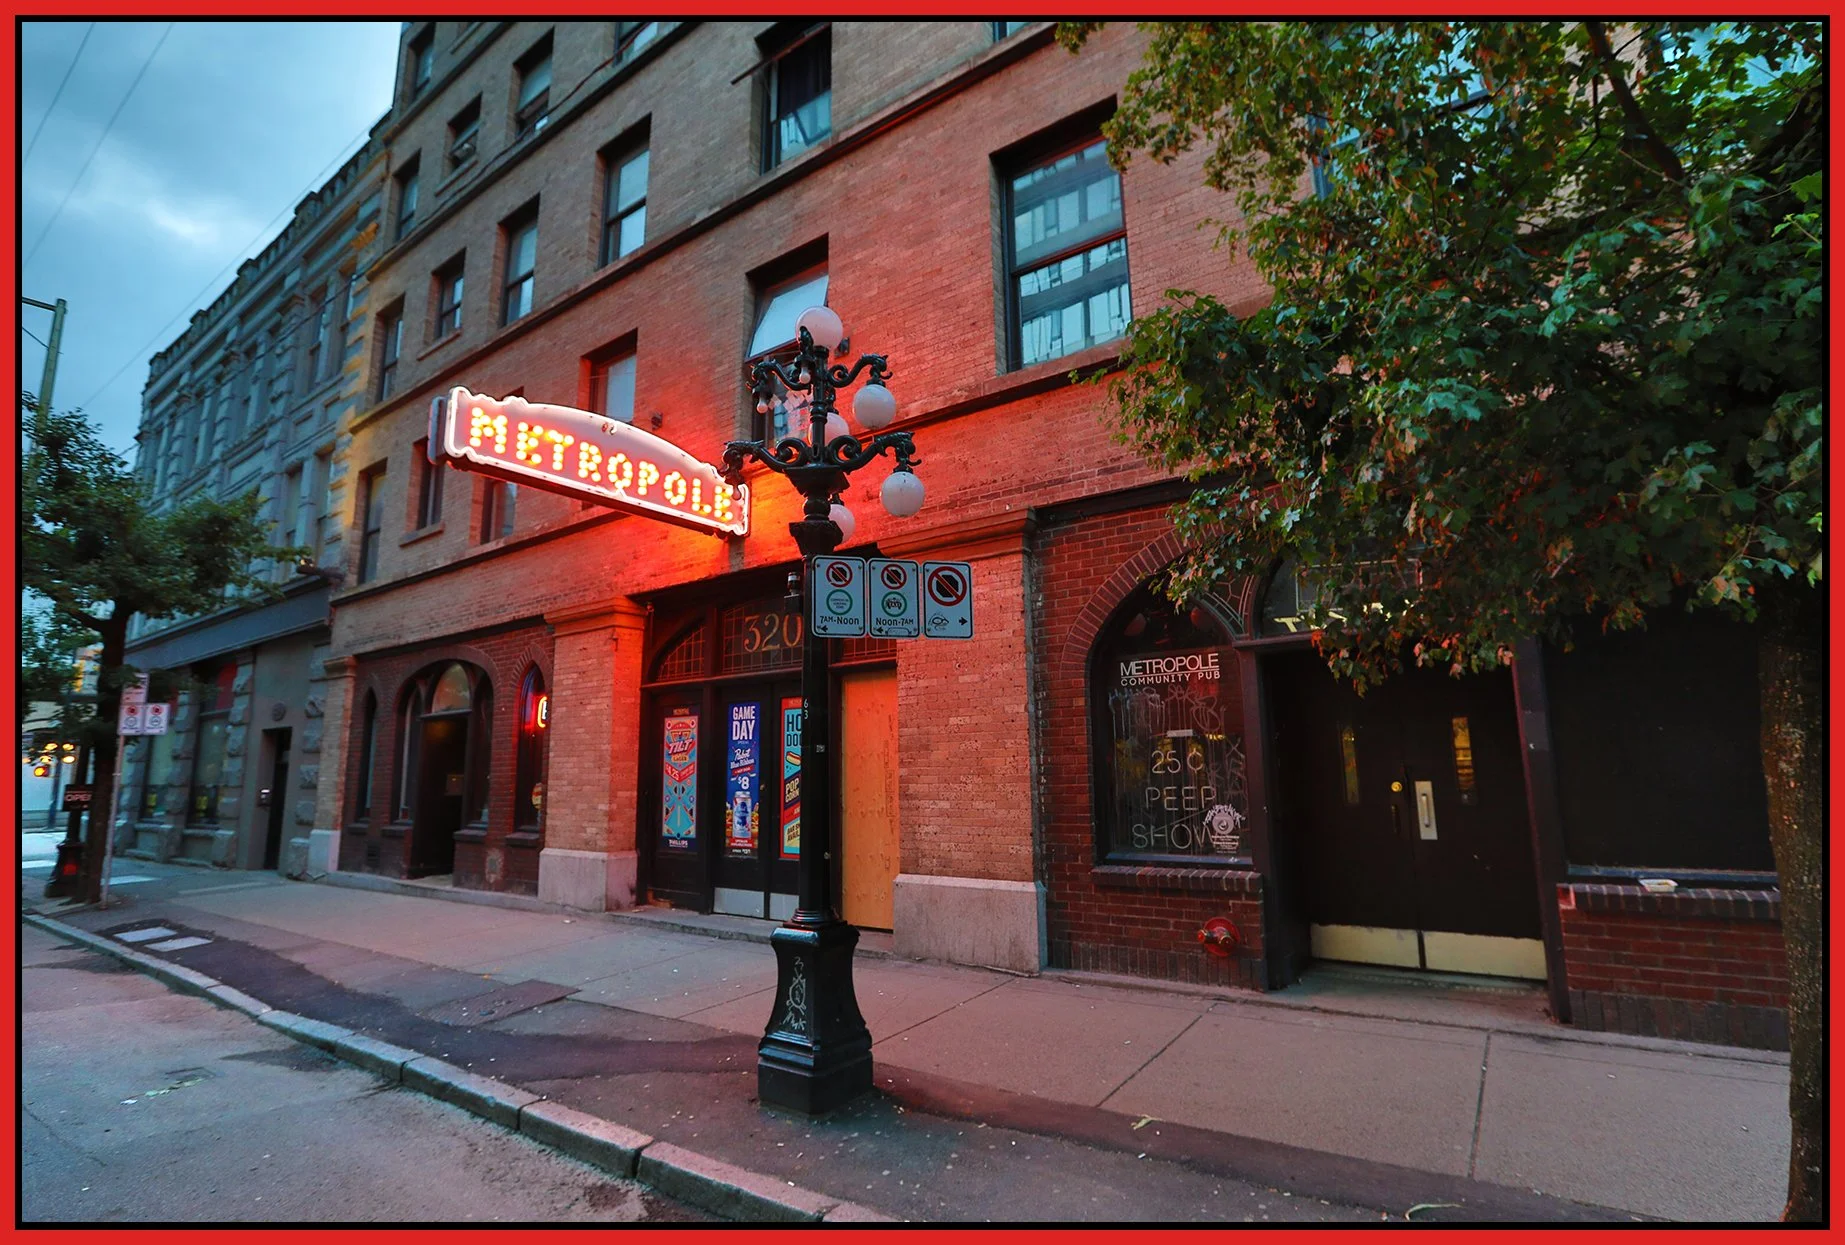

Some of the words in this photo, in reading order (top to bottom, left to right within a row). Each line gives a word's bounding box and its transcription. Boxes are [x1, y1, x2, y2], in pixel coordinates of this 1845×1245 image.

[469, 407, 732, 520] METROPOLE
[820, 616, 860, 625] 7AM-Noon
[876, 618, 914, 626] Noon-7AM
[744, 613, 803, 652] 320
[1120, 653, 1219, 676] METROPOLE
[1120, 673, 1190, 686] COMMUNITY
[1198, 671, 1220, 680] PUB
[732, 706, 756, 720] GAME
[732, 720, 756, 740] DAY
[786, 714, 802, 731] HO
[669, 739, 692, 754] TILT
[786, 733, 801, 747] DO
[738, 776, 750, 790] $8
[1145, 786, 1217, 811] PEEP
[1132, 823, 1217, 850] SHOW
